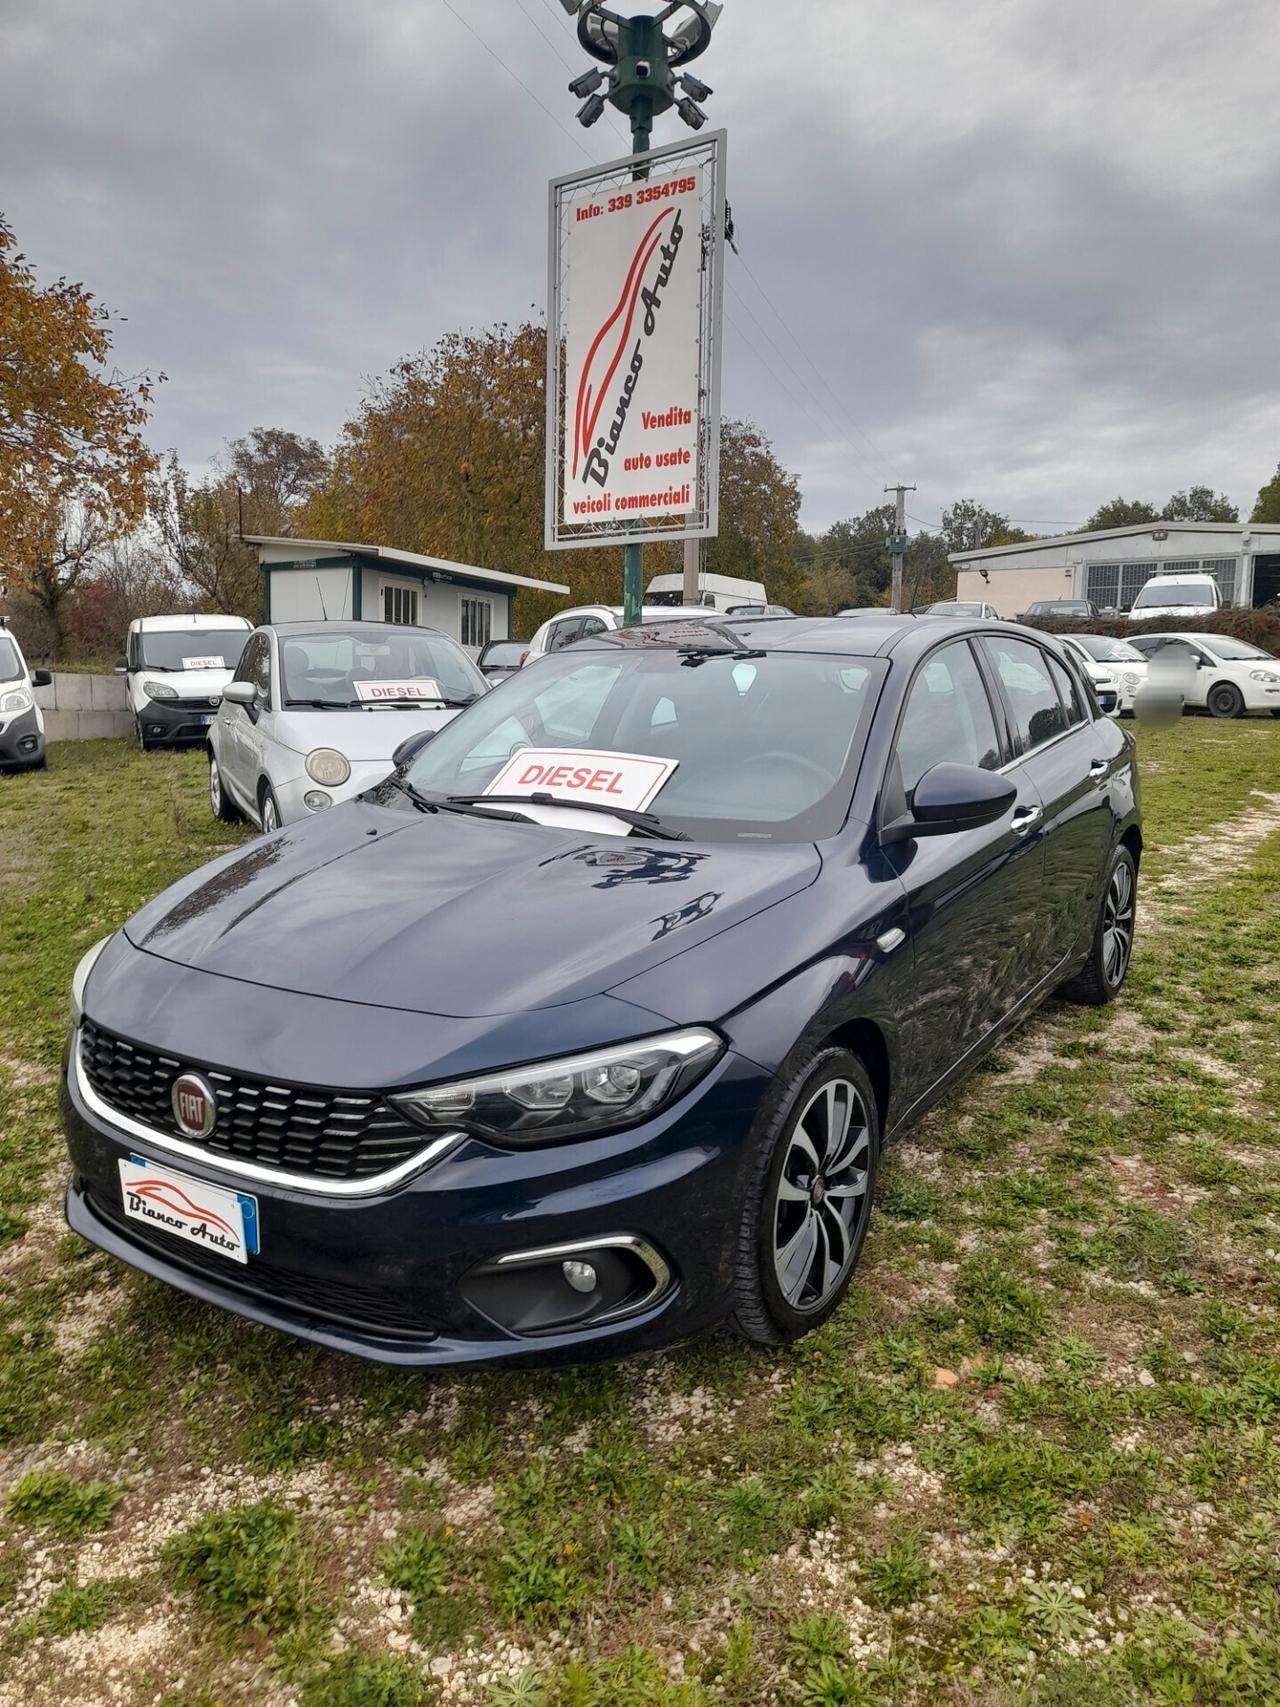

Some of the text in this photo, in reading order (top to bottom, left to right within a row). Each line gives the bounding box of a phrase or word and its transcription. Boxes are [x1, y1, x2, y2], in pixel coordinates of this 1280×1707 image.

[576, 176, 696, 222] Info: 339 3354795
[582, 208, 684, 488] Bianco Auto
[641, 406, 692, 430] Vendita
[623, 447, 691, 472] auto usate
[573, 484, 690, 514] veicoli commerciali
[371, 687, 426, 698] DIESEL
[517, 765, 624, 794] DIESEL
[179, 1092, 204, 1123] FIAT
[126, 1191, 240, 1252] Bianco Auto
